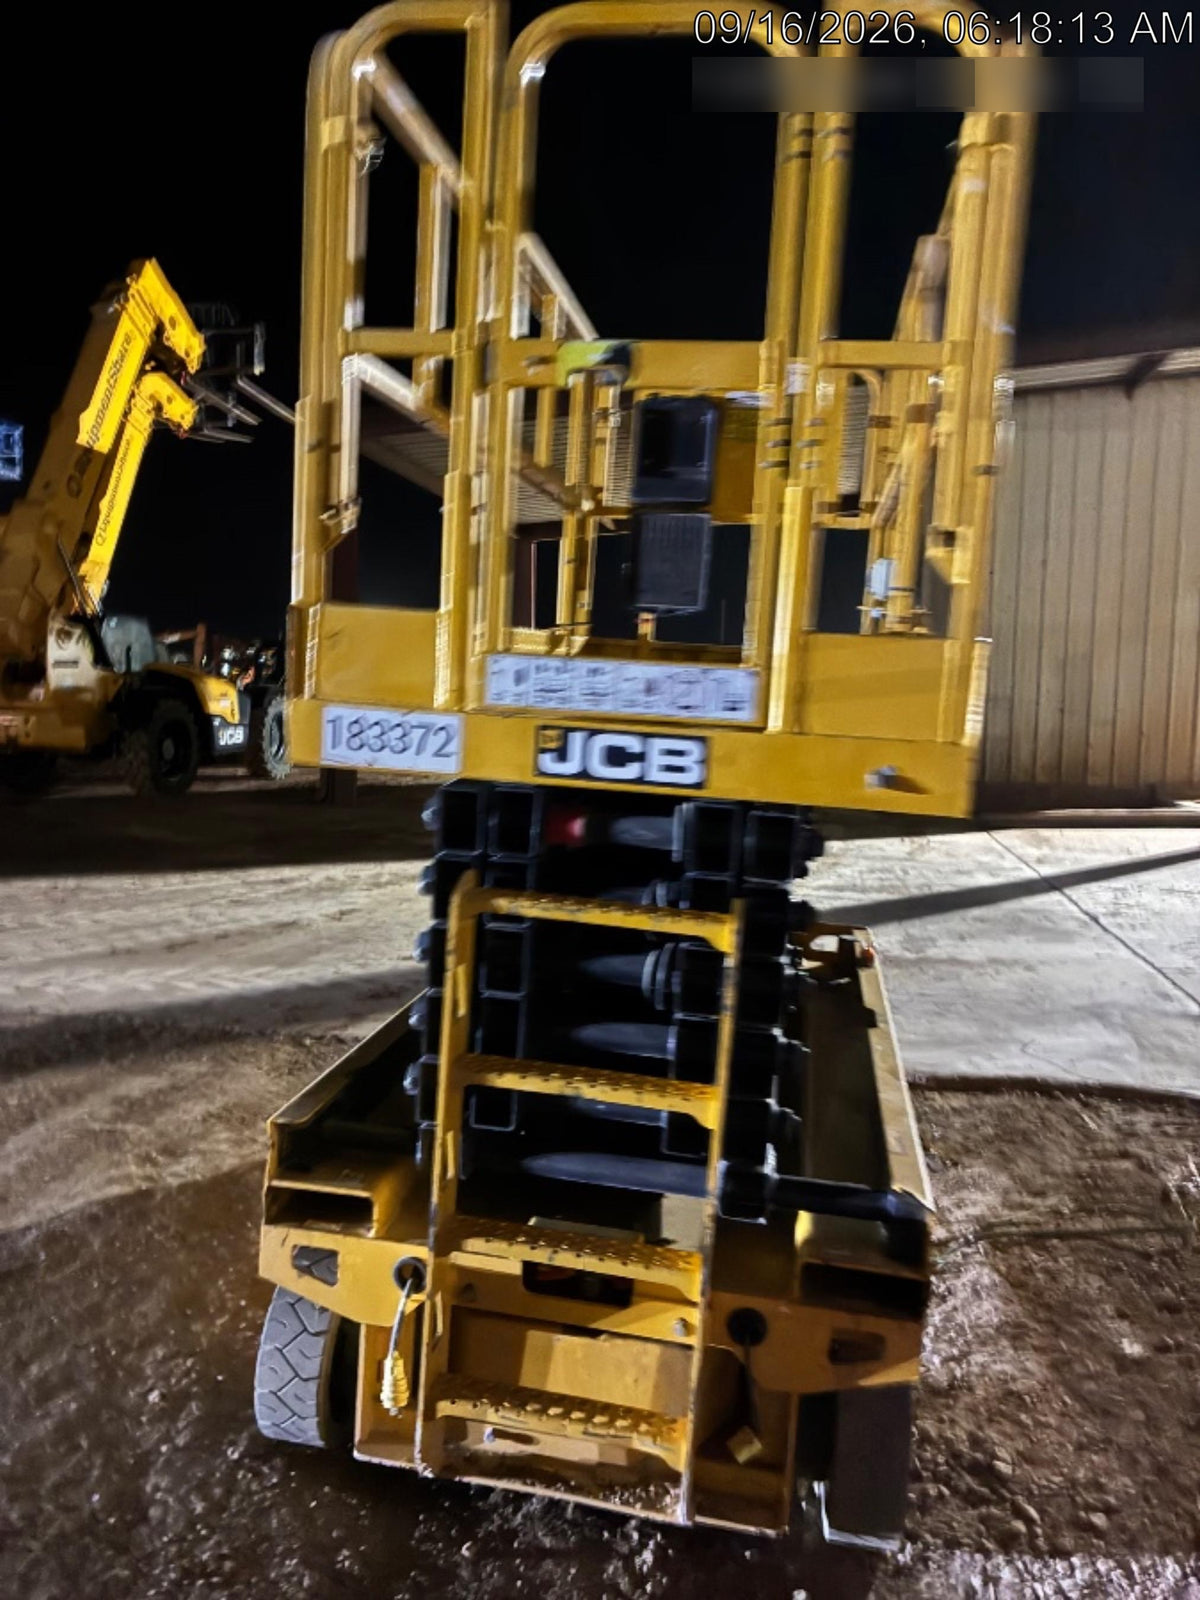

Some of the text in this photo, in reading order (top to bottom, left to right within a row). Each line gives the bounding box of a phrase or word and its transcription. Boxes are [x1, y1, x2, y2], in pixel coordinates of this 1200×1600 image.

[218, 725, 244, 746] JCB
[326, 714, 460, 758] 183372
[537, 729, 707, 785] JCB
